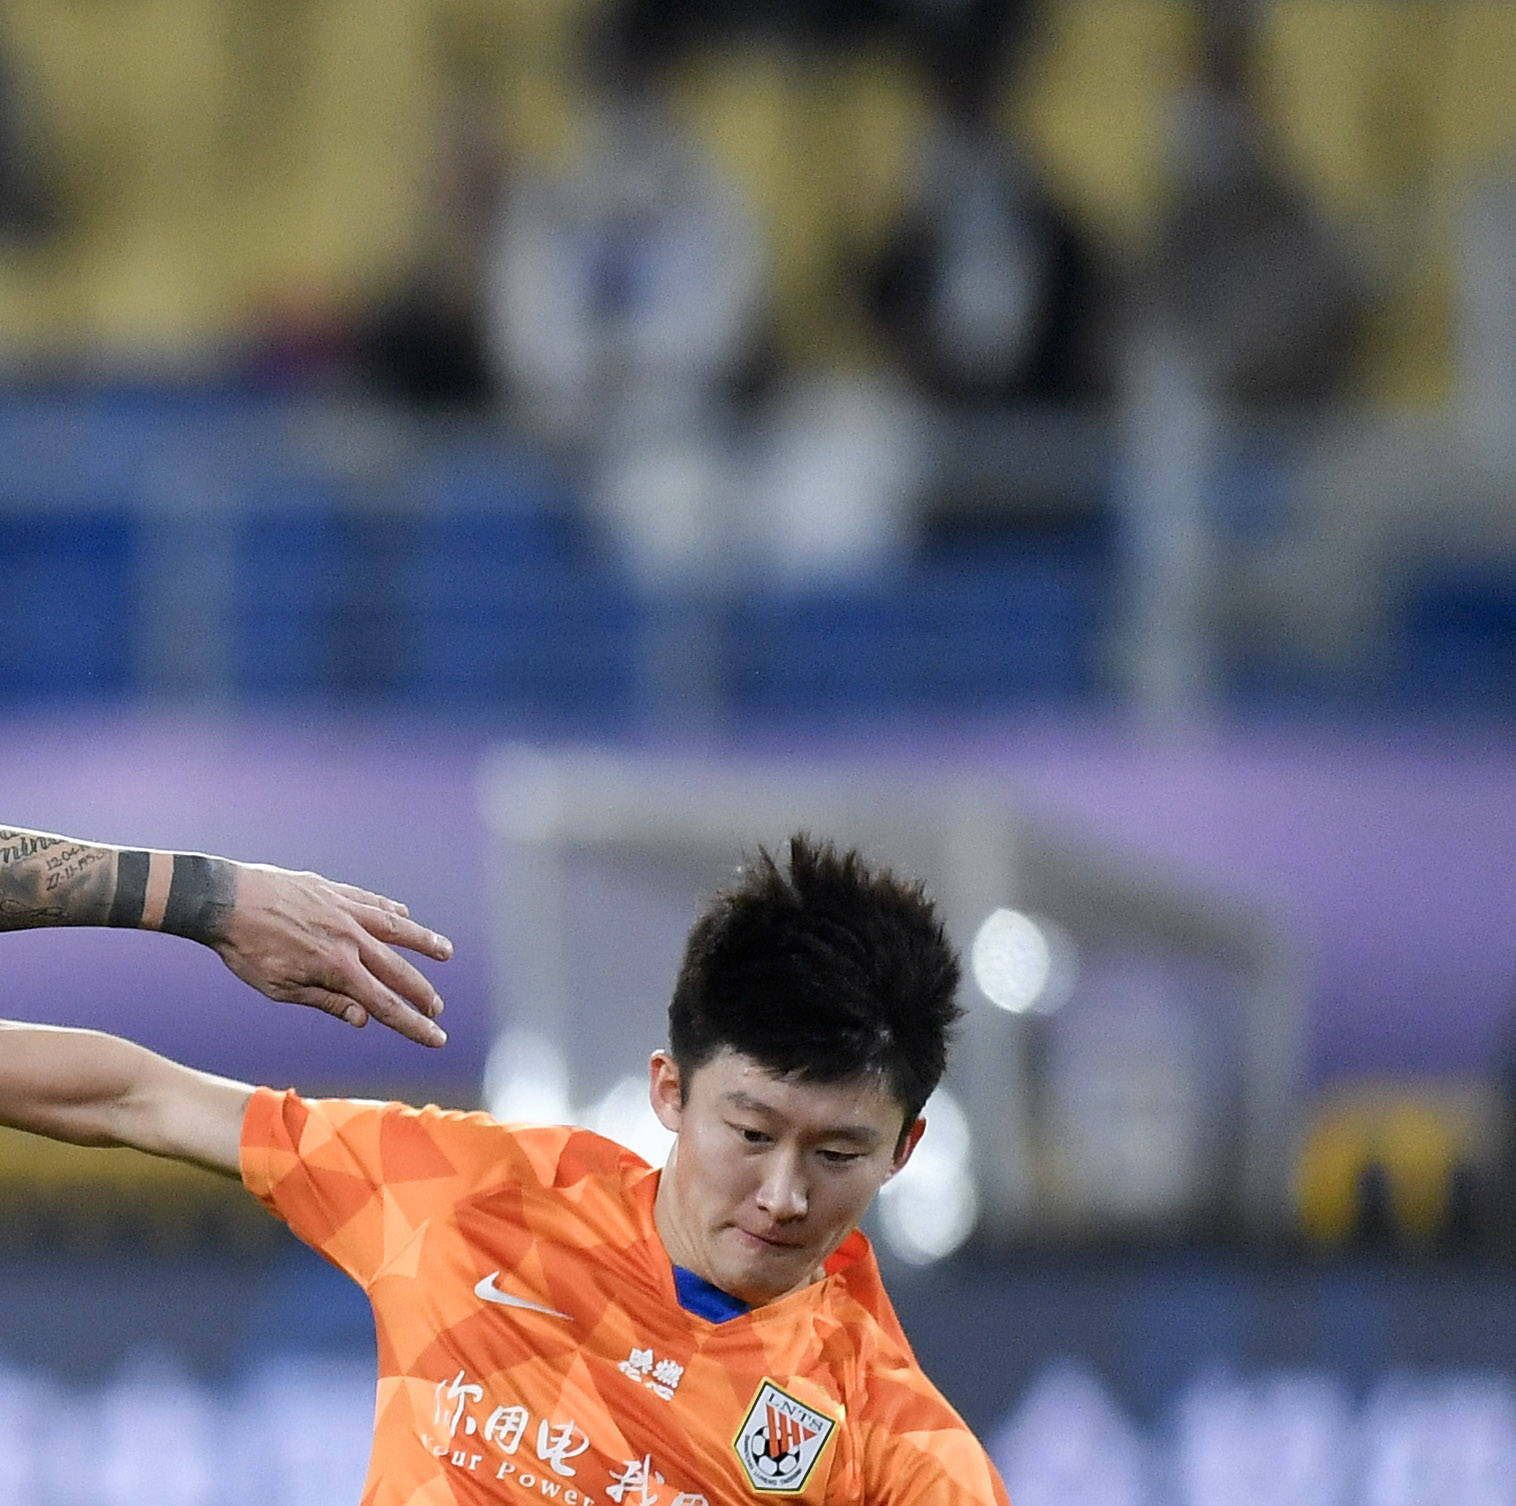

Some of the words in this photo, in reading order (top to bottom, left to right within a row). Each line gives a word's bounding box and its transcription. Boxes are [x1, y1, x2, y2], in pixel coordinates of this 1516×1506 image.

[433, 1370, 590, 1477] 你用电
[768, 1393, 824, 1431] LNTS
